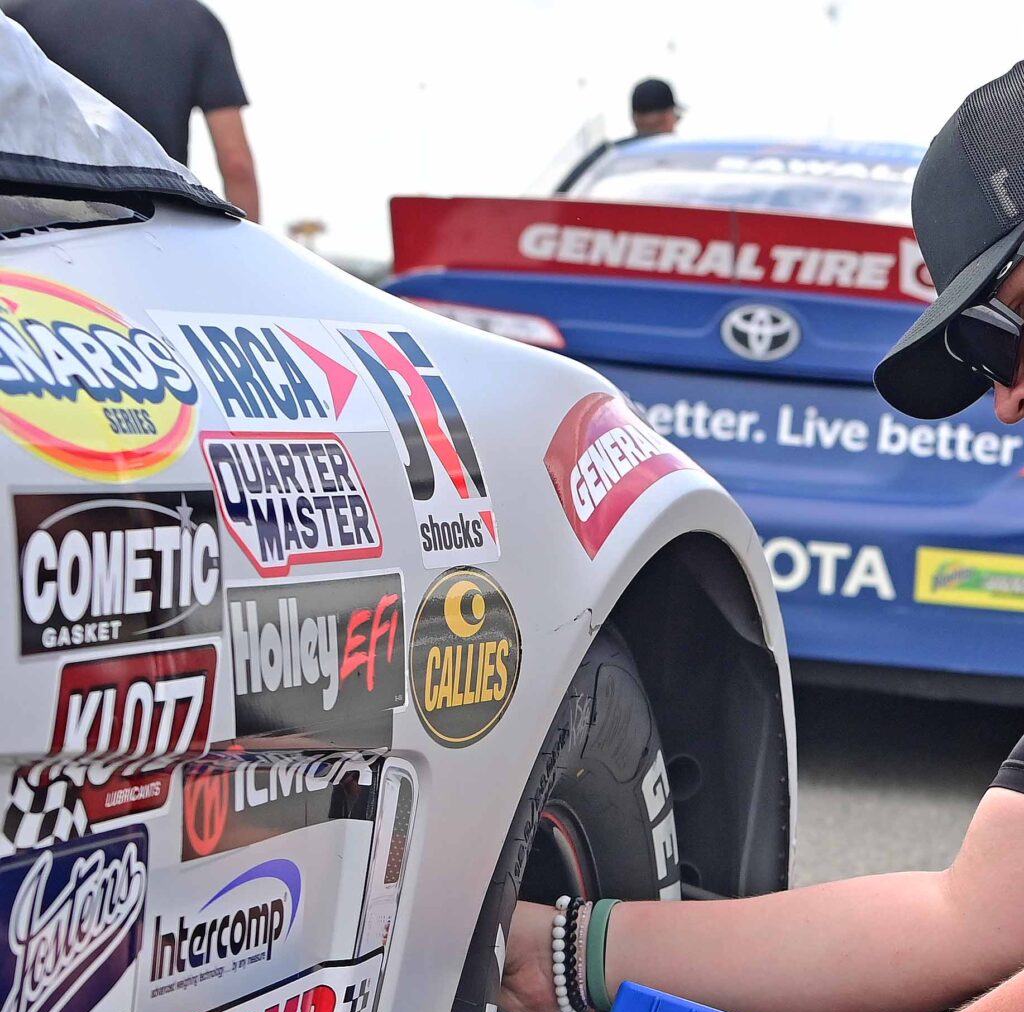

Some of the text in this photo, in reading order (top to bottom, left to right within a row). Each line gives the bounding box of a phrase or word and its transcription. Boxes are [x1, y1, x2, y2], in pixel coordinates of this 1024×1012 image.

[519, 222, 897, 292] GENERAL TIRE
[178, 324, 328, 421] ARCA
[103, 407, 156, 435] SERIES
[777, 404, 868, 455] Live
[877, 411, 1024, 468] better
[207, 443, 357, 526] QUARTER
[570, 424, 664, 523] GENERA
[251, 495, 375, 563] MASTER
[421, 513, 485, 551] shocks
[22, 522, 220, 625] COMETIC
[762, 535, 896, 601] OTA
[41, 620, 123, 649] GASKET
[230, 597, 341, 711] Holley
[424, 639, 511, 713] CALLIES
[150, 898, 285, 982] Intercomp
